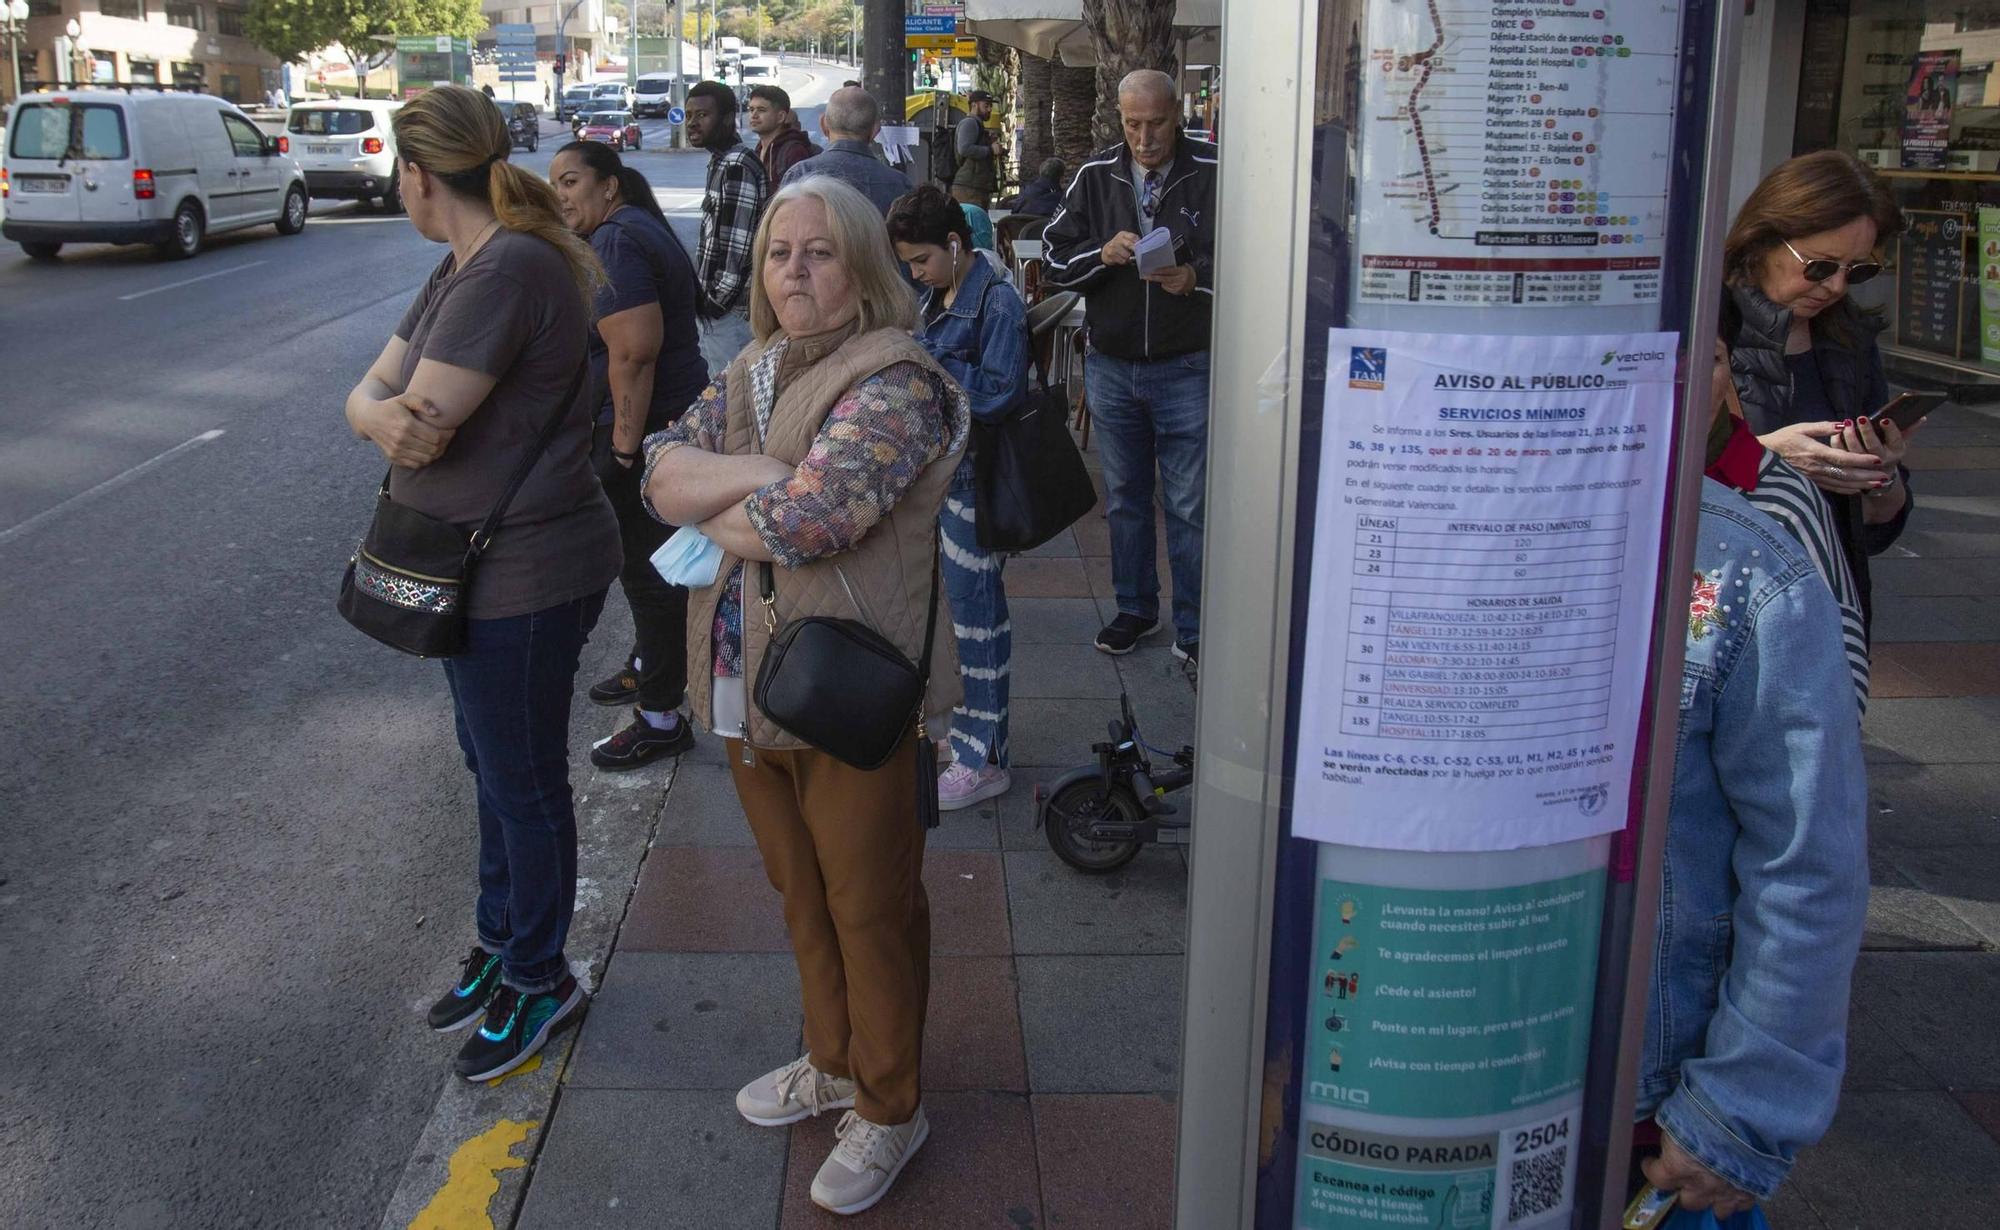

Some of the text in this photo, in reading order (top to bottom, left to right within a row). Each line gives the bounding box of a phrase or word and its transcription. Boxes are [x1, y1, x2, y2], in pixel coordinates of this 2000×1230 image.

[1492, 8, 1590, 18] Complejo Vistahermosa
[906, 18, 942, 26] ALICANTE
[1491, 20, 1517, 28] ONCE
[1558, 33, 1598, 43] de servicio
[1490, 45, 1569, 55] Hospital Sant Joan
[1489, 58, 1574, 69] Avenida del Hospital
[1488, 70, 1537, 78] Alicante 51
[1488, 82, 1523, 90] Alicante
[1488, 94, 1527, 104] Mayor 71
[1487, 107, 1585, 117] Mayor Plaza de España
[1486, 119, 1542, 128] Cervantes 26
[1486, 132, 1569, 140] Mutxamel Salt
[1485, 144, 1528, 152] Mutxamel
[1484, 156, 1520, 164] Alicante
[1483, 168, 1519, 176] Alicante
[1483, 180, 1510, 188] Carlos
[1512, 180, 1534, 188] Soler
[1482, 192, 1533, 200] Carlos Soler
[1481, 204, 1533, 212] Carlos Soler
[1480, 216, 1582, 226] José Luis Jiménez Vargas
[1480, 235, 1552, 244] Mutxamel IES
[1364, 258, 1438, 269] Intervalo de paso
[1616, 351, 1665, 362] vectalia
[1354, 370, 1384, 381] TAM
[1434, 374, 1495, 389] AVISO
[1502, 375, 1525, 389] AL
[1531, 372, 1604, 389] PÚBLICO
[1439, 406, 1586, 420] SERVICIOS MÍNIMOS
[1372, 425, 1384, 434] Se
[1387, 426, 1422, 436] informa
[1449, 429, 1474, 438] Sres.
[1349, 441, 1448, 456] 36, 38 135, que
[1347, 459, 1462, 473] podrán verse modificados
[1346, 478, 1357, 486] En
[1361, 479, 1370, 488] el
[1373, 481, 1414, 491] siguiente
[1416, 483, 1448, 492] cuadro
[1344, 496, 1458, 510] la Generalitat Valenciana.
[1360, 517, 1396, 529] LÍNEAS
[1448, 520, 1592, 532] INTERVALO DE PASO (MINUTOS)
[1370, 534, 1382, 543] 21
[1514, 538, 1532, 547] 120
[1369, 549, 1382, 558] 23
[1368, 564, 1380, 573] 24
[1514, 568, 1527, 577] 60
[1467, 596, 1562, 608] HORARIOS DE SALIDA
[1363, 616, 1376, 624] 26
[1361, 645, 1374, 654] 30
[1384, 698, 1519, 710] REALIZA SERVICIO COMPLETO
[1352, 716, 1370, 726] 135
[1324, 747, 1344, 758] Las
[1383, 754, 1406, 764] C-6,
[1507, 756, 1523, 765] U1,
[1567, 748, 1578, 757] 45
[1604, 743, 1614, 751] no
[1339, 762, 1371, 774] verán
[1375, 766, 1429, 777] afectadas
[1432, 769, 1449, 778] por
[1465, 769, 1495, 779] huelga
[1500, 769, 1514, 778] por
[1528, 766, 1544, 775] que
[1322, 772, 1362, 784] habitual.
[1382, 890, 1586, 917] ¡Levanta la mano! Avisa al conductor
[1380, 913, 1550, 932] cuando necesites subir al bus
[1378, 938, 1568, 963] Te agradecemos el importe exacto
[1376, 984, 1476, 998] ¡Cede el asiento!
[1372, 1016, 1538, 1038] Ponte en mi lugar, pero no en
[1369, 1048, 1546, 1073] ¡Avisa con tiempo al conductor!
[1310, 1082, 1369, 1104] mia
[1514, 1116, 1569, 1154] 2504
[1311, 1132, 1493, 1164] CÓDIGO PARADA
[1314, 1171, 1435, 1199] Escanea el código
[1312, 1188, 1424, 1212] y conoce el tiempo
[1312, 1200, 1430, 1224] de paso del autobús
